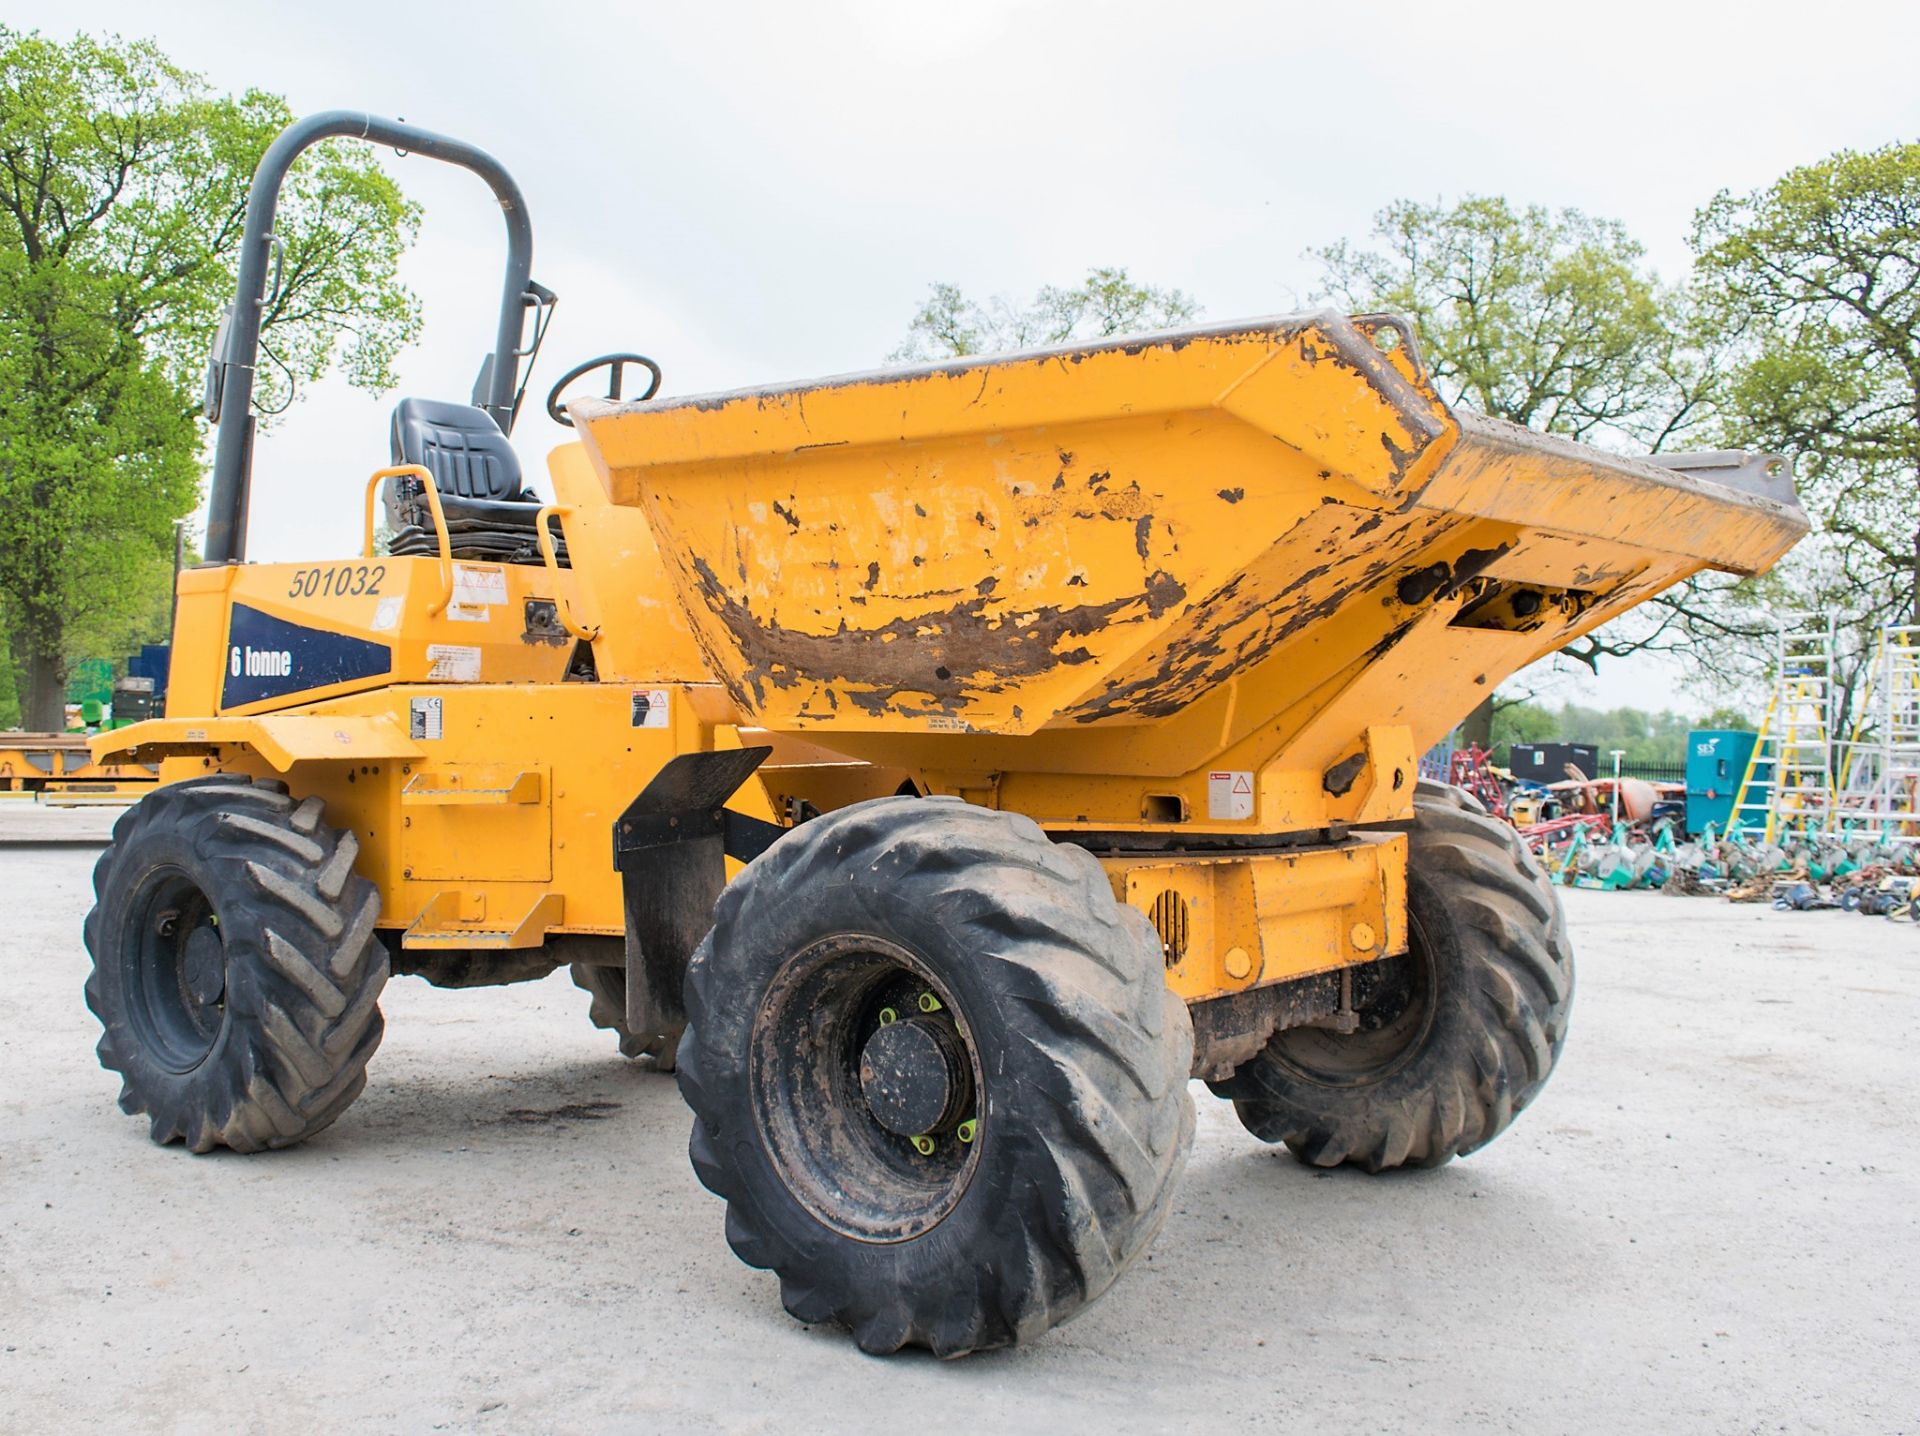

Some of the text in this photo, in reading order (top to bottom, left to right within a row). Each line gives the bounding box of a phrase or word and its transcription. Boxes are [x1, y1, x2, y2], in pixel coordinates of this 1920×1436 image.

[288, 565, 386, 598] 501032
[230, 645, 292, 677] 6 tonne
[1697, 744, 1715, 753] SES
